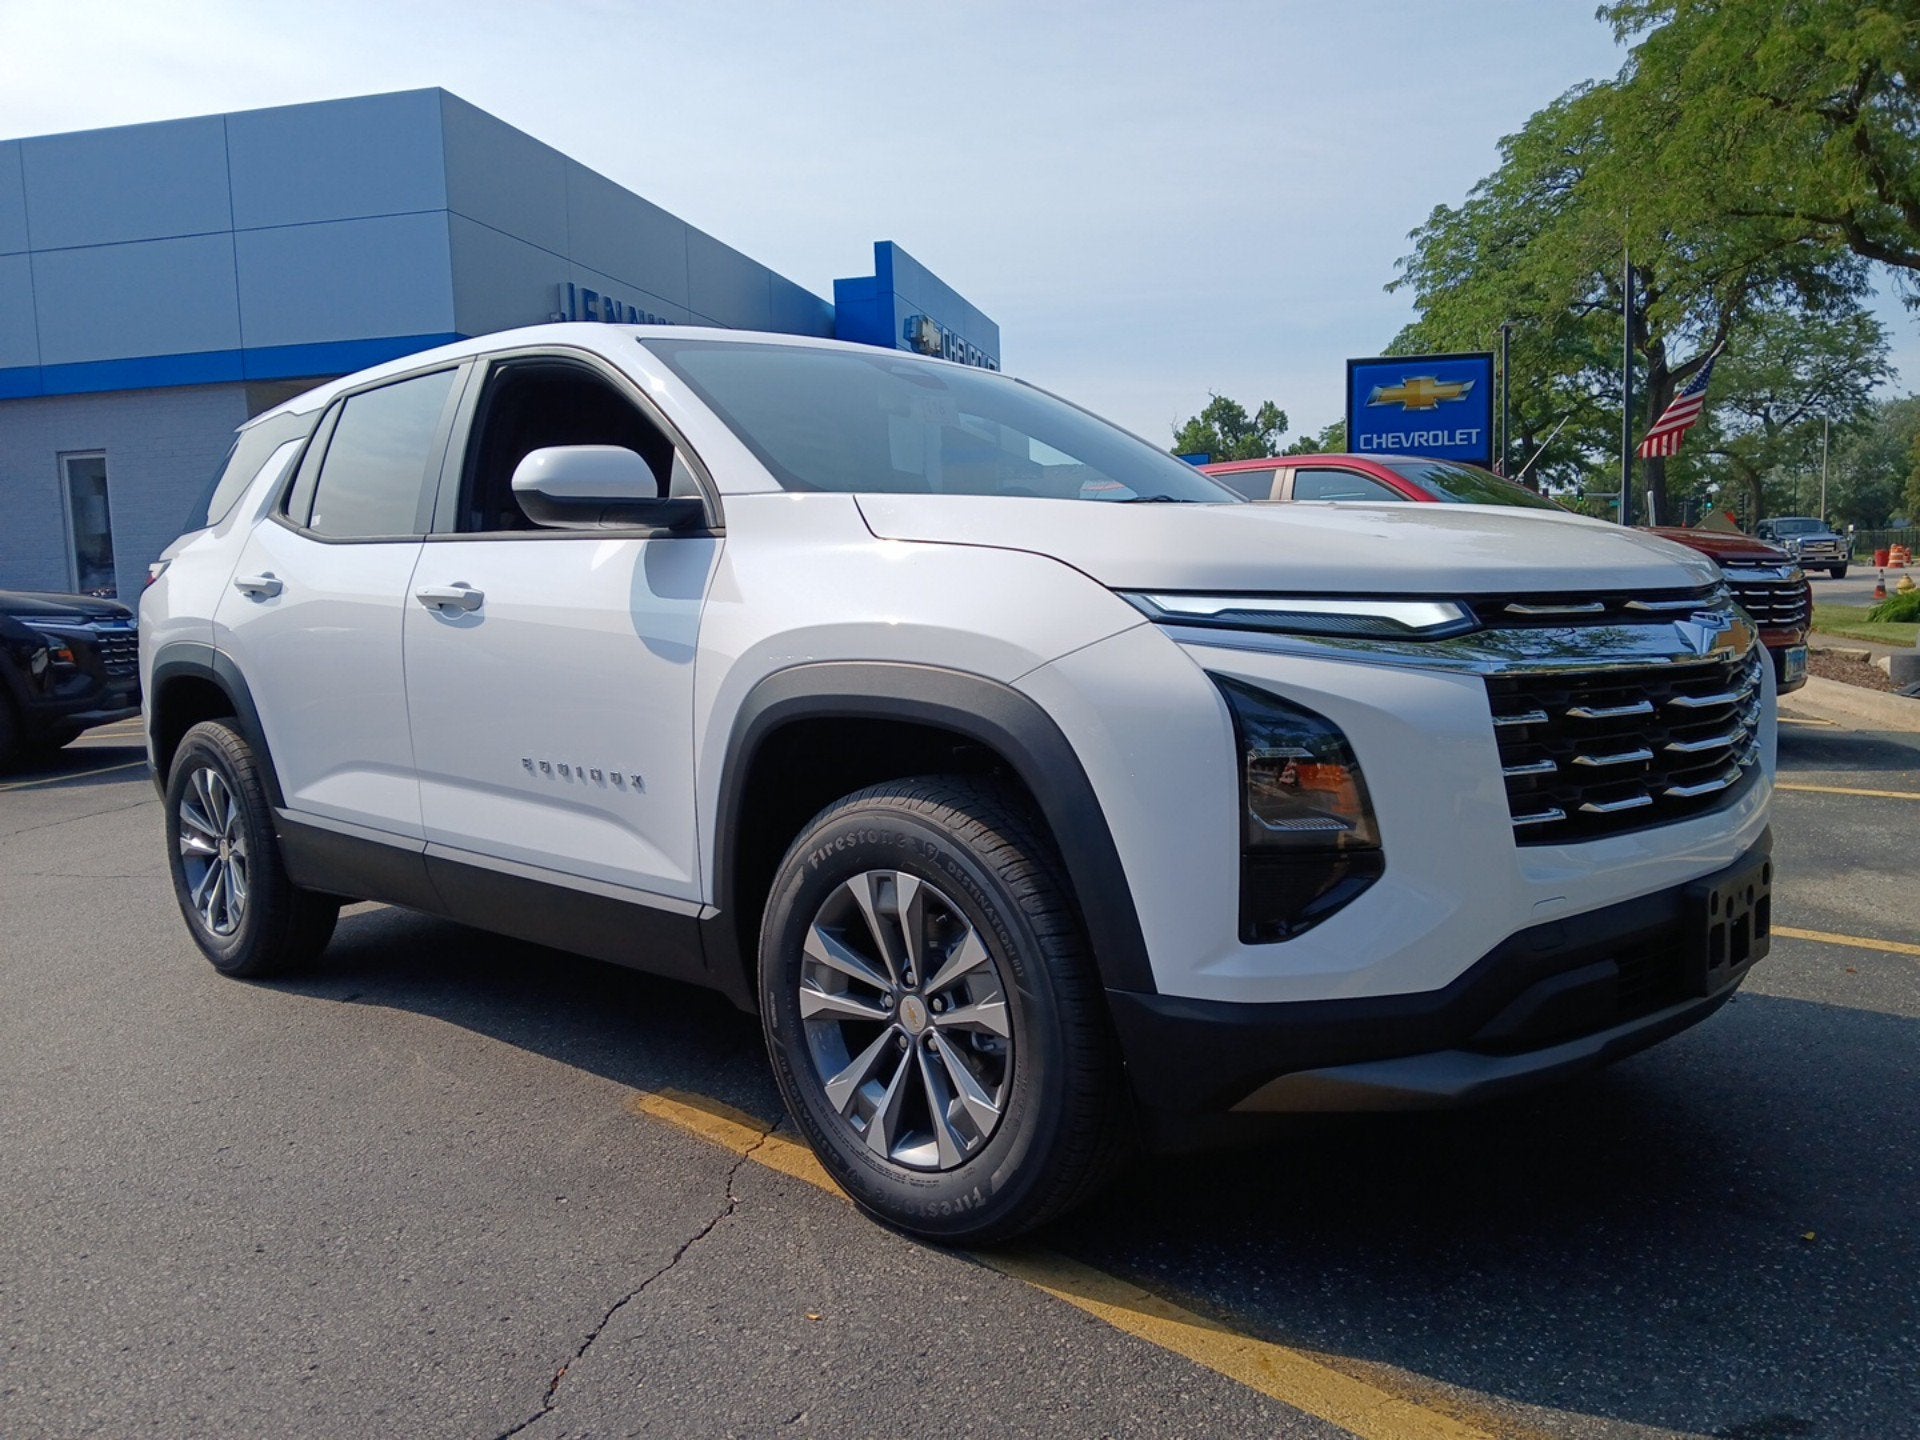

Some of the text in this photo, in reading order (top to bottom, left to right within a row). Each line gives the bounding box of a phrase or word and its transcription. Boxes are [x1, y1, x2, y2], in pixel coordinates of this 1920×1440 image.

[1360, 428, 1481, 450] CHEVROLET
[521, 756, 643, 789] EQUINOX
[807, 828, 907, 870] Firestone
[947, 861, 1016, 957] DESTINATION
